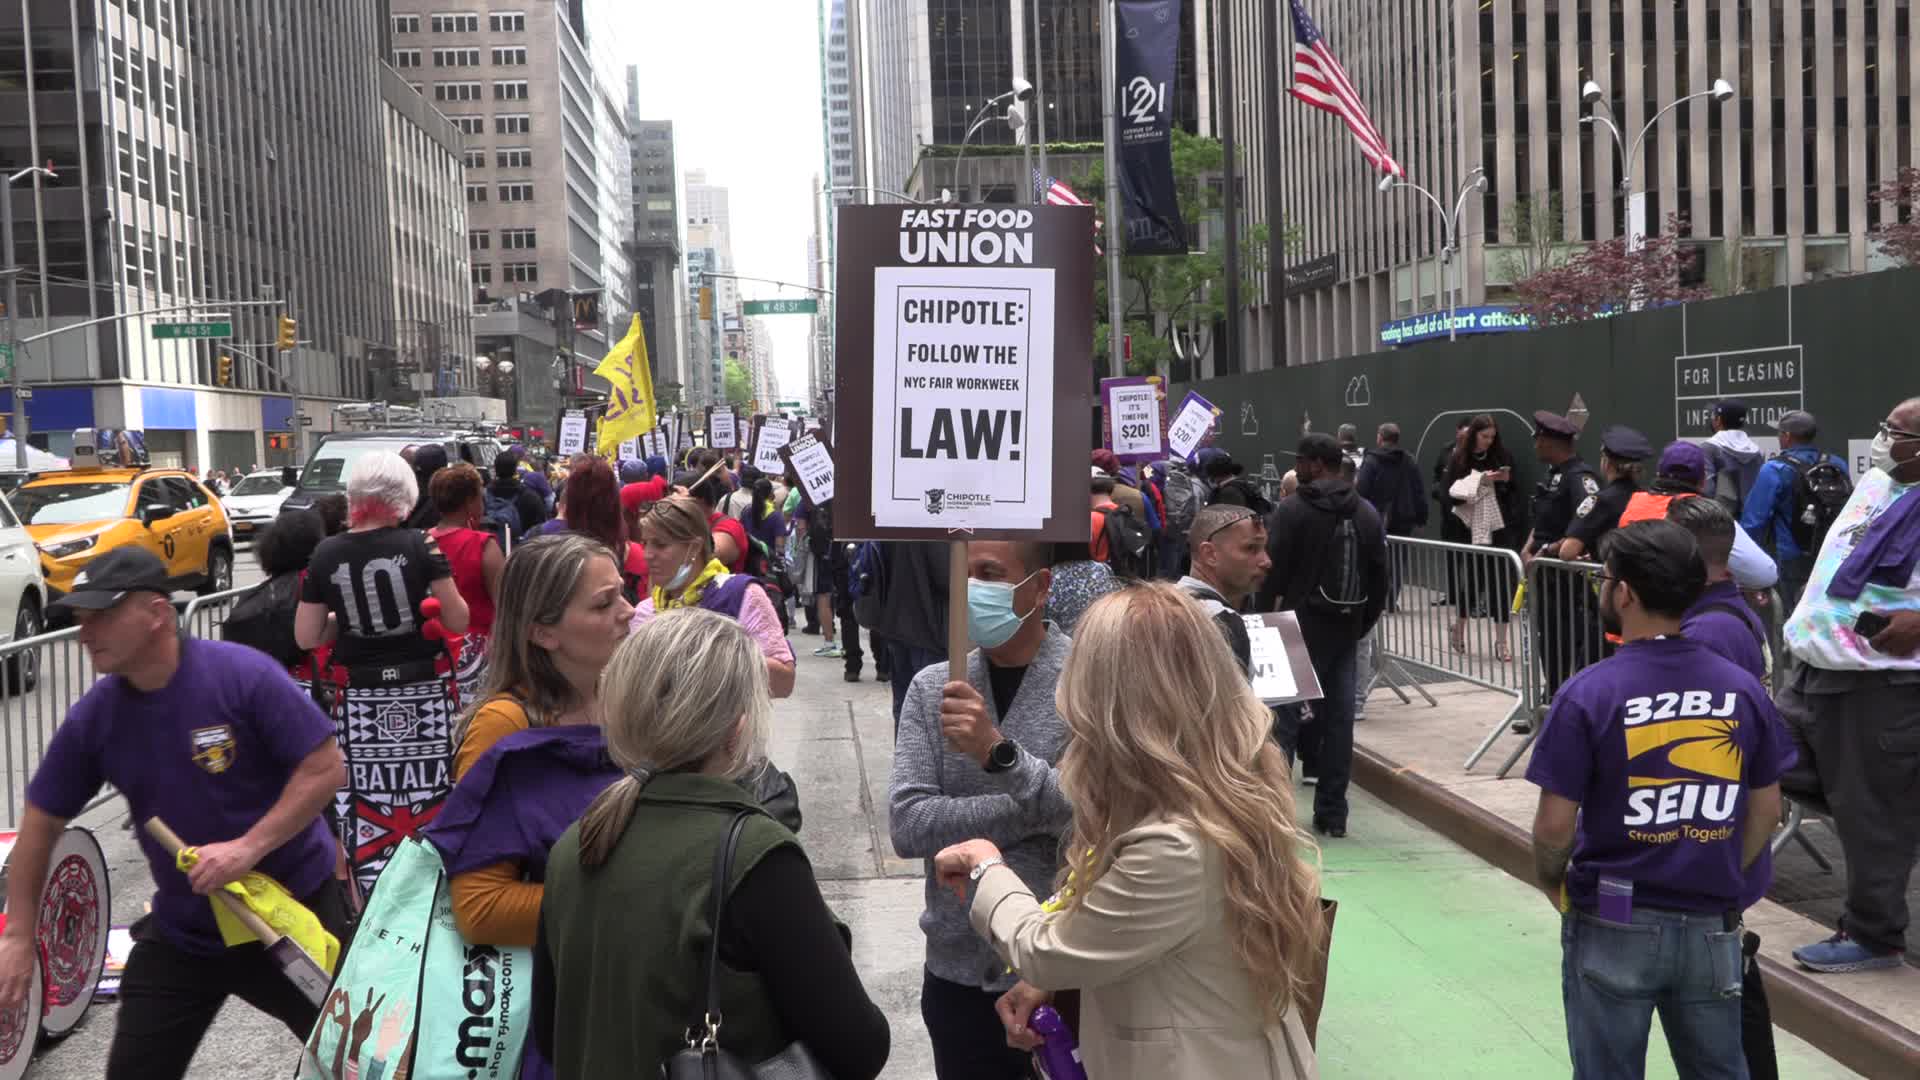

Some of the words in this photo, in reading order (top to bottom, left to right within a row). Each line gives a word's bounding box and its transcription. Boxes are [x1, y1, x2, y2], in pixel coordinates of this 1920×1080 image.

[900, 209, 961, 229] FAST
[963, 209, 1034, 229] FOOD
[900, 231, 1033, 264] UNION
[762, 303, 770, 313] W
[773, 302, 785, 312] 48
[903, 299, 1024, 326] CHIPOTLE:
[1402, 321, 1413, 337] has
[1414, 316, 1428, 335] died
[1429, 314, 1437, 332] of
[908, 344, 980, 365] FOLLOW
[983, 345, 1018, 365] THE
[904, 376, 926, 389] NYC
[929, 376, 953, 389] FAIR
[956, 377, 1020, 391] WORKWEEK
[1683, 368, 1710, 385] FOR
[1727, 360, 1795, 383] LEASING
[900, 407, 1022, 461] LAW!
[1121, 423, 1150, 439] $20!
[946, 493, 992, 501] CHIPOTLE
[1623, 690, 1737, 726] 32BJ
[352, 760, 449, 791] BATALA
[1623, 784, 1740, 826] SEIU
[488, 1041, 507, 1079] shop
